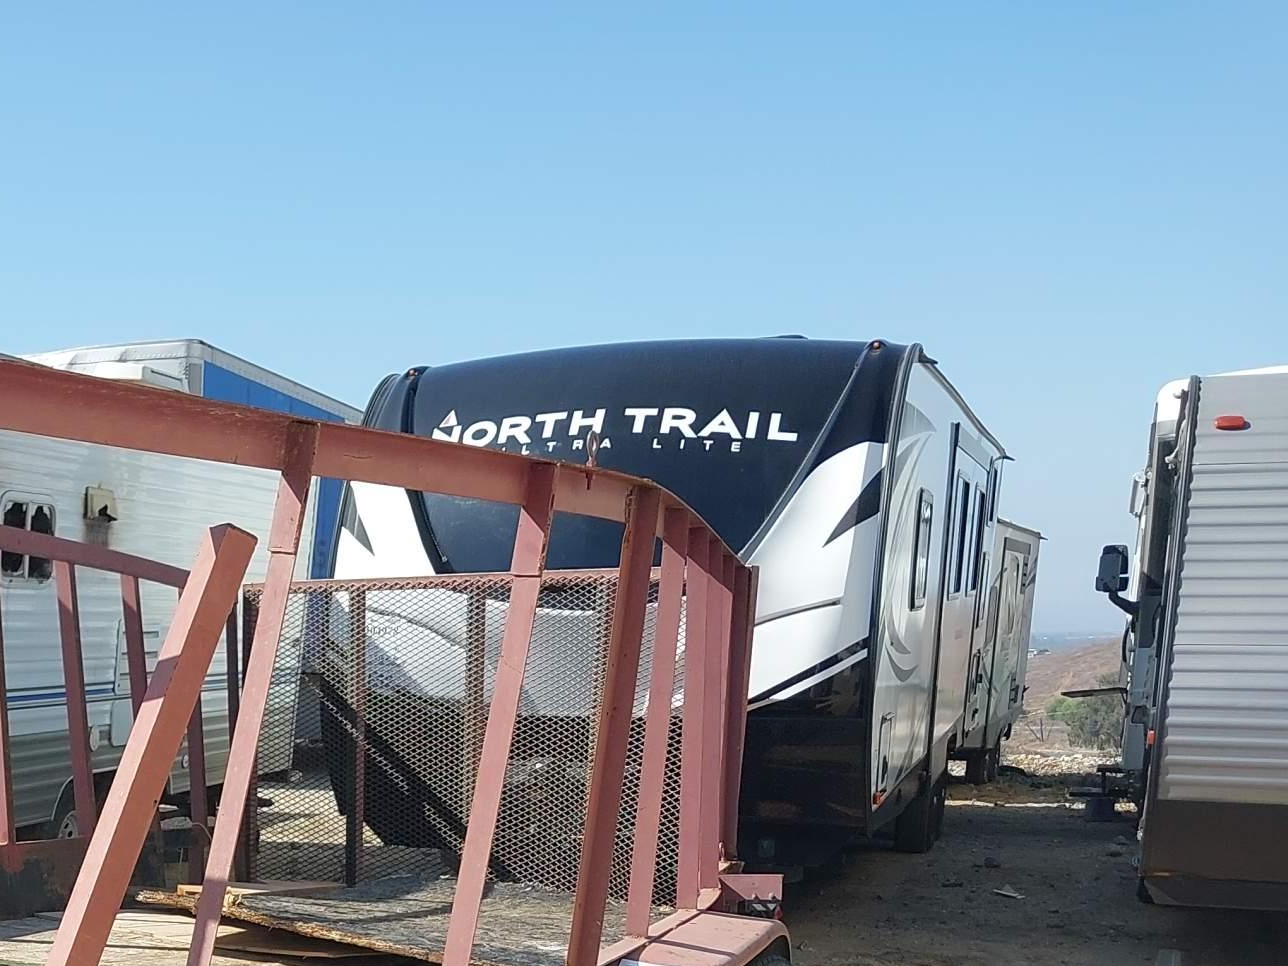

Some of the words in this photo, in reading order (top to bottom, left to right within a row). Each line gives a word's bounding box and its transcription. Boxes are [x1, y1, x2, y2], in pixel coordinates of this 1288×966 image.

[431, 408, 606, 448] NORTH
[624, 407, 799, 442] TRAIL
[501, 438, 612, 456] LTRA
[653, 437, 742, 453] LITE
